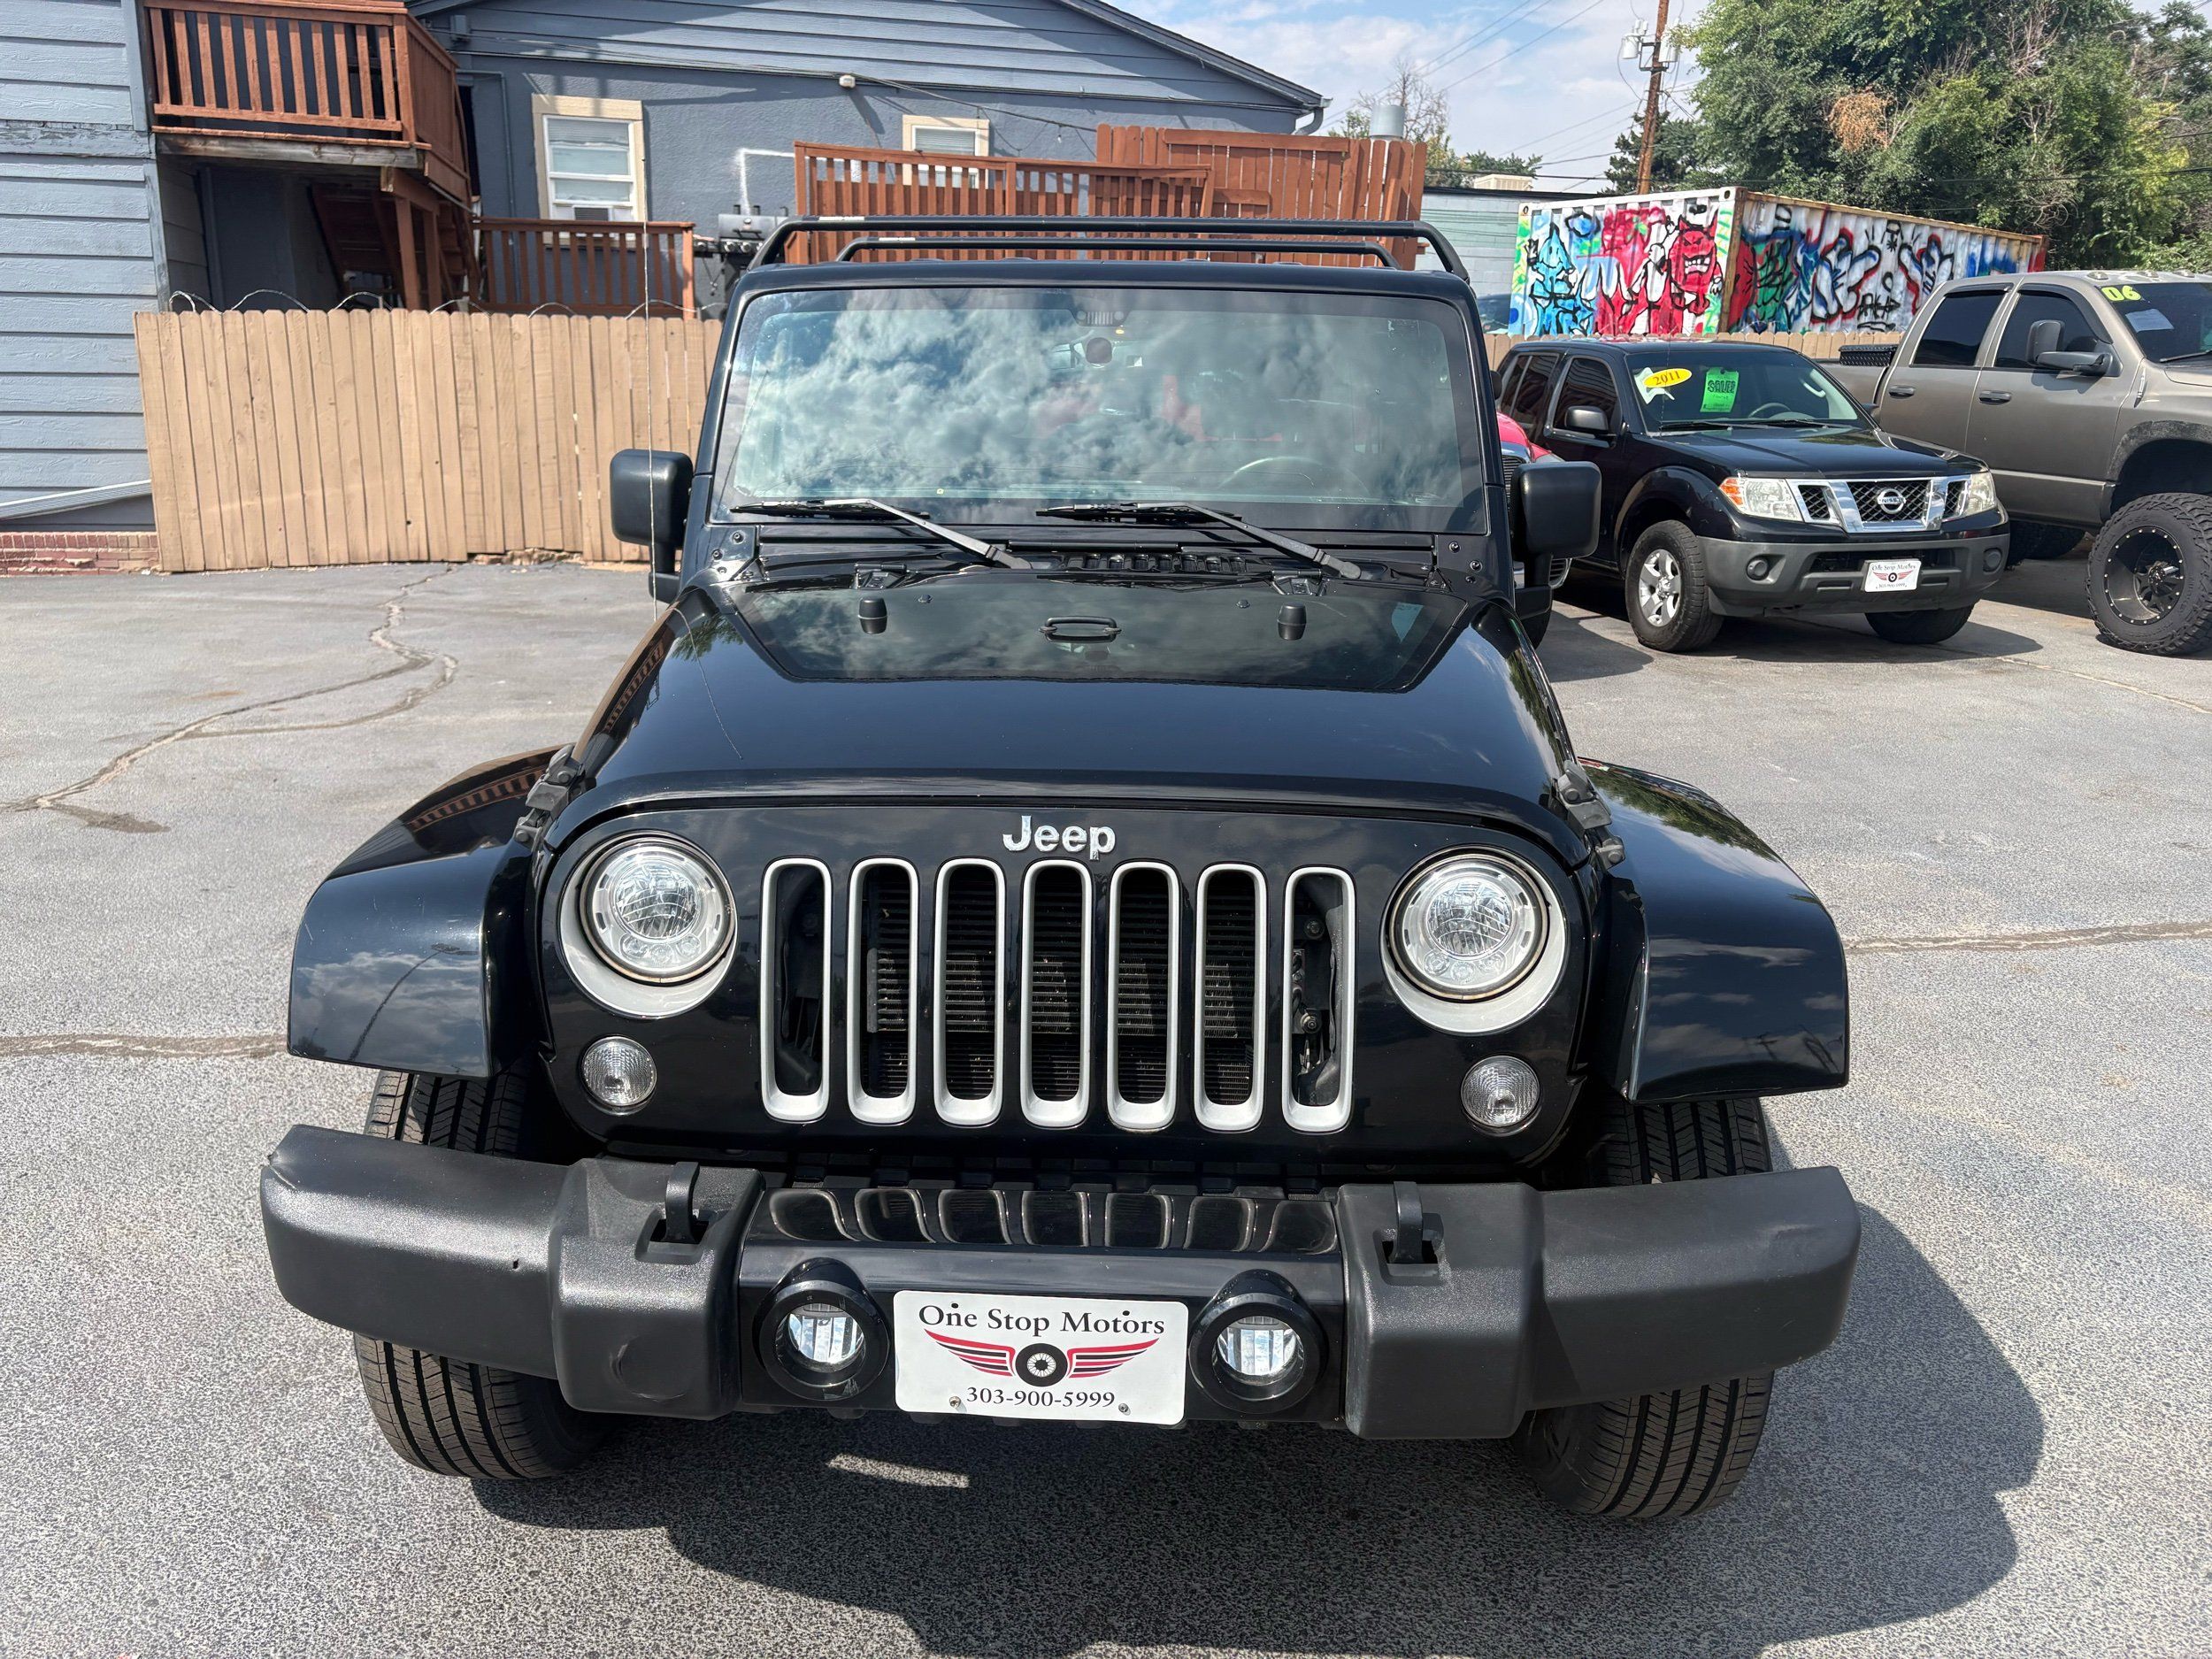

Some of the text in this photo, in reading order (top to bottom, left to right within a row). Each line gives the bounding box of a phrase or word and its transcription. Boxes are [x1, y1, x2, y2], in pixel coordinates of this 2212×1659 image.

[2101, 285, 2141, 301] 06
[1653, 371, 1681, 385] 2011
[1002, 815, 1116, 860] Jeep
[918, 1305, 1165, 1337] One Stop Motors
[966, 1386, 1115, 1409] 303-900-5999
